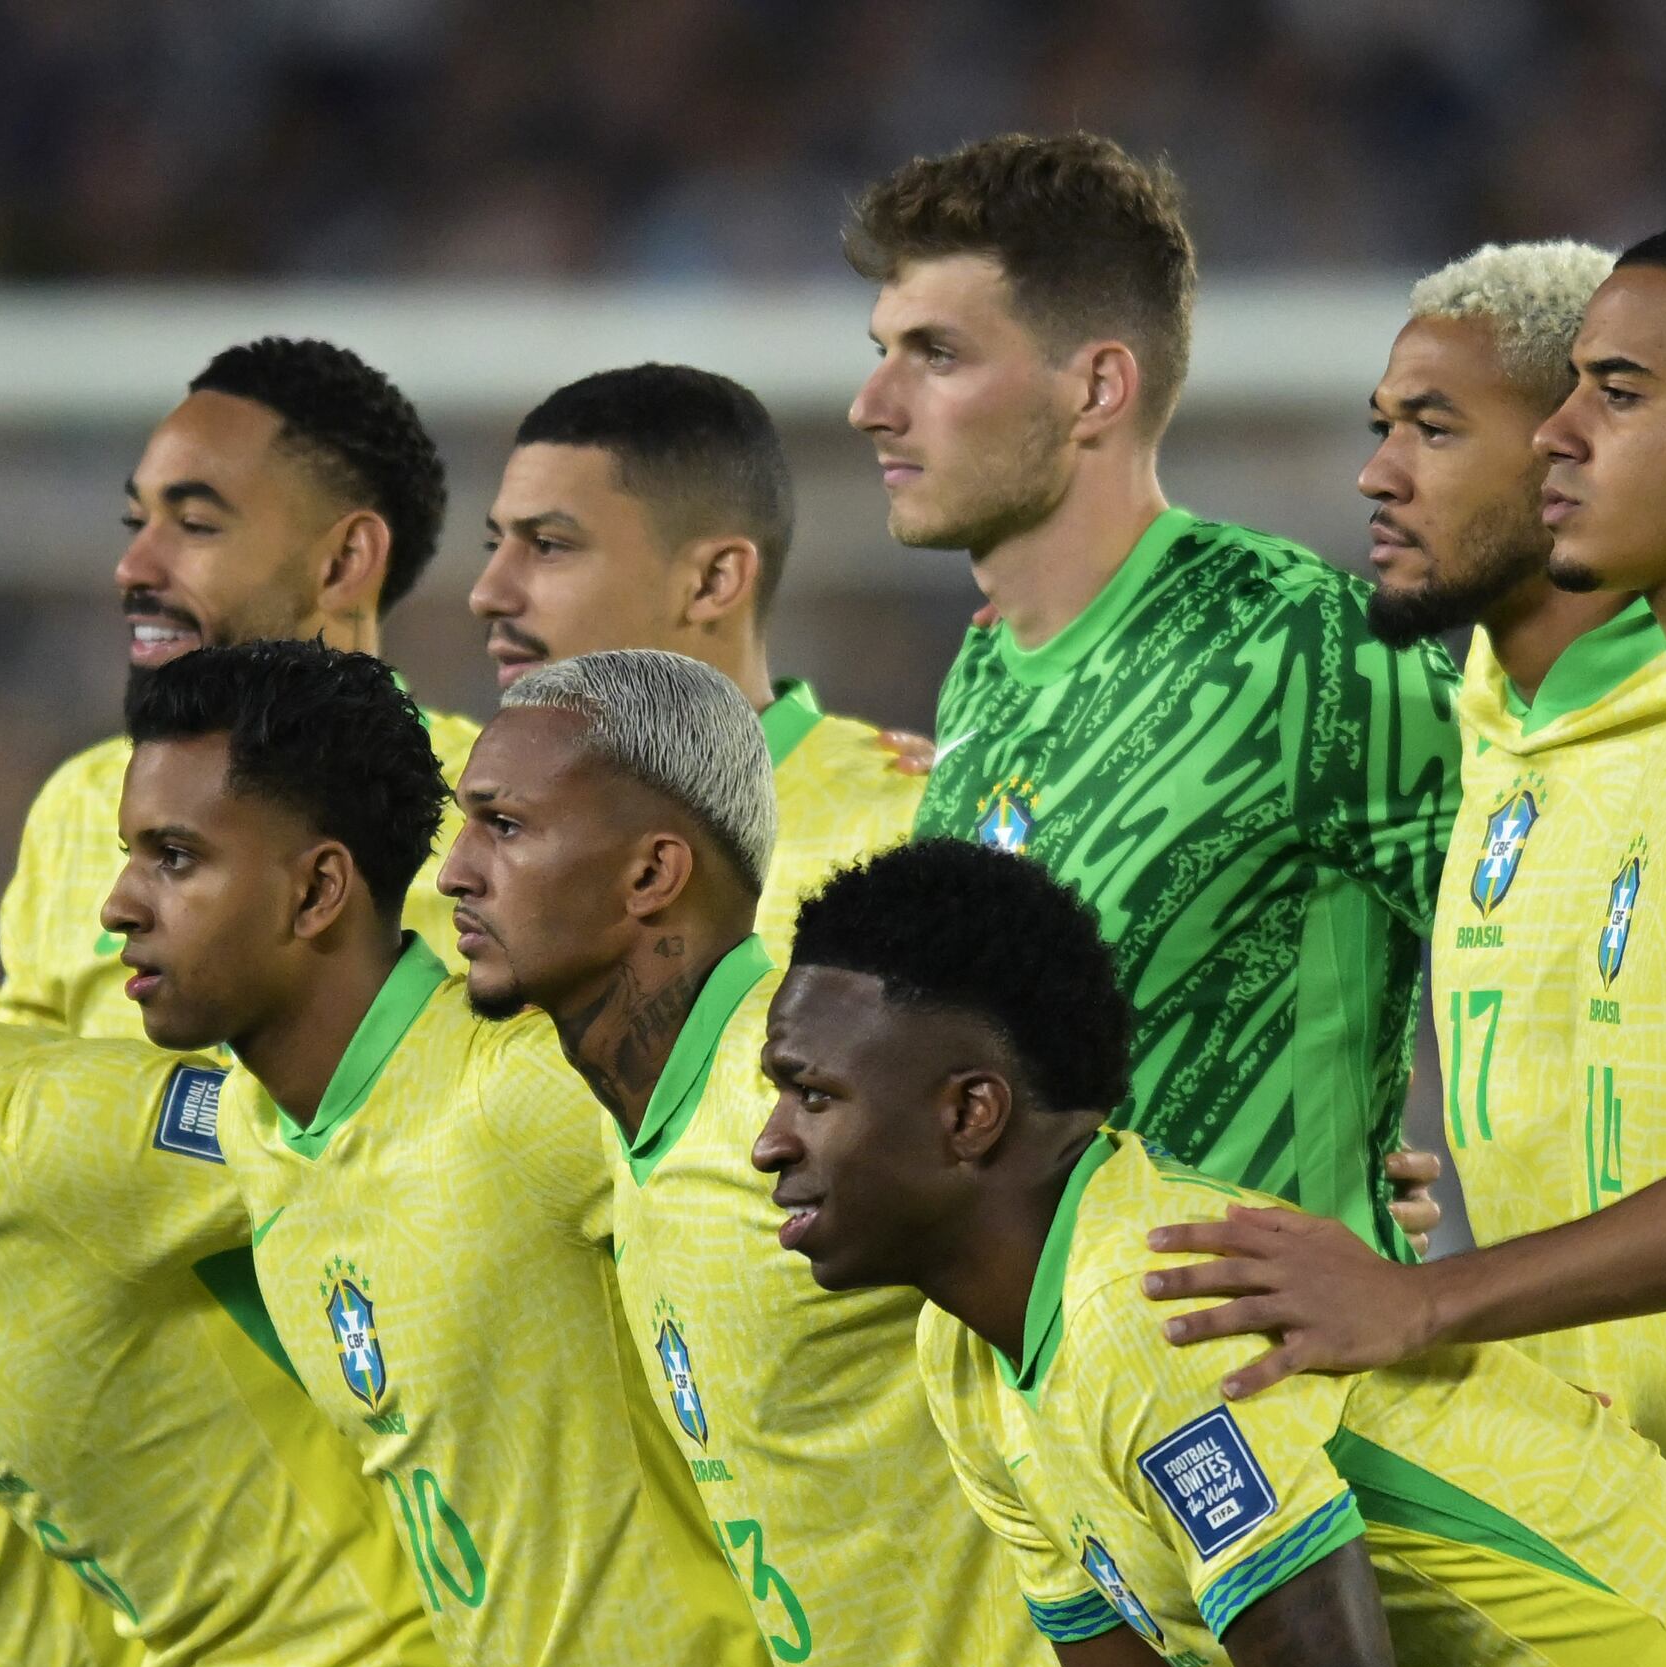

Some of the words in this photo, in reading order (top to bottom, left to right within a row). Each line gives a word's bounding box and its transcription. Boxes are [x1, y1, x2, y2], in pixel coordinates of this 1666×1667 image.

[1492, 841, 1511, 857] CBF
[1456, 925, 1504, 949] BRASIL
[1589, 998, 1622, 1025] BRASIL
[1449, 989, 1503, 1149] 17
[179, 1079, 208, 1133] FOOTBALL
[195, 1083, 222, 1137] UNITES
[1585, 1065, 1623, 1213] 14
[347, 1332, 365, 1350] CBF
[691, 1459, 734, 1483] BRASIL
[1163, 1436, 1222, 1479] FOOTBALL
[1173, 1451, 1232, 1498] UNITES
[1186, 1496, 1206, 1518] the
[1201, 1467, 1245, 1507] World
[1211, 1505, 1235, 1524] FIFA
[385, 1468, 488, 1613] 10
